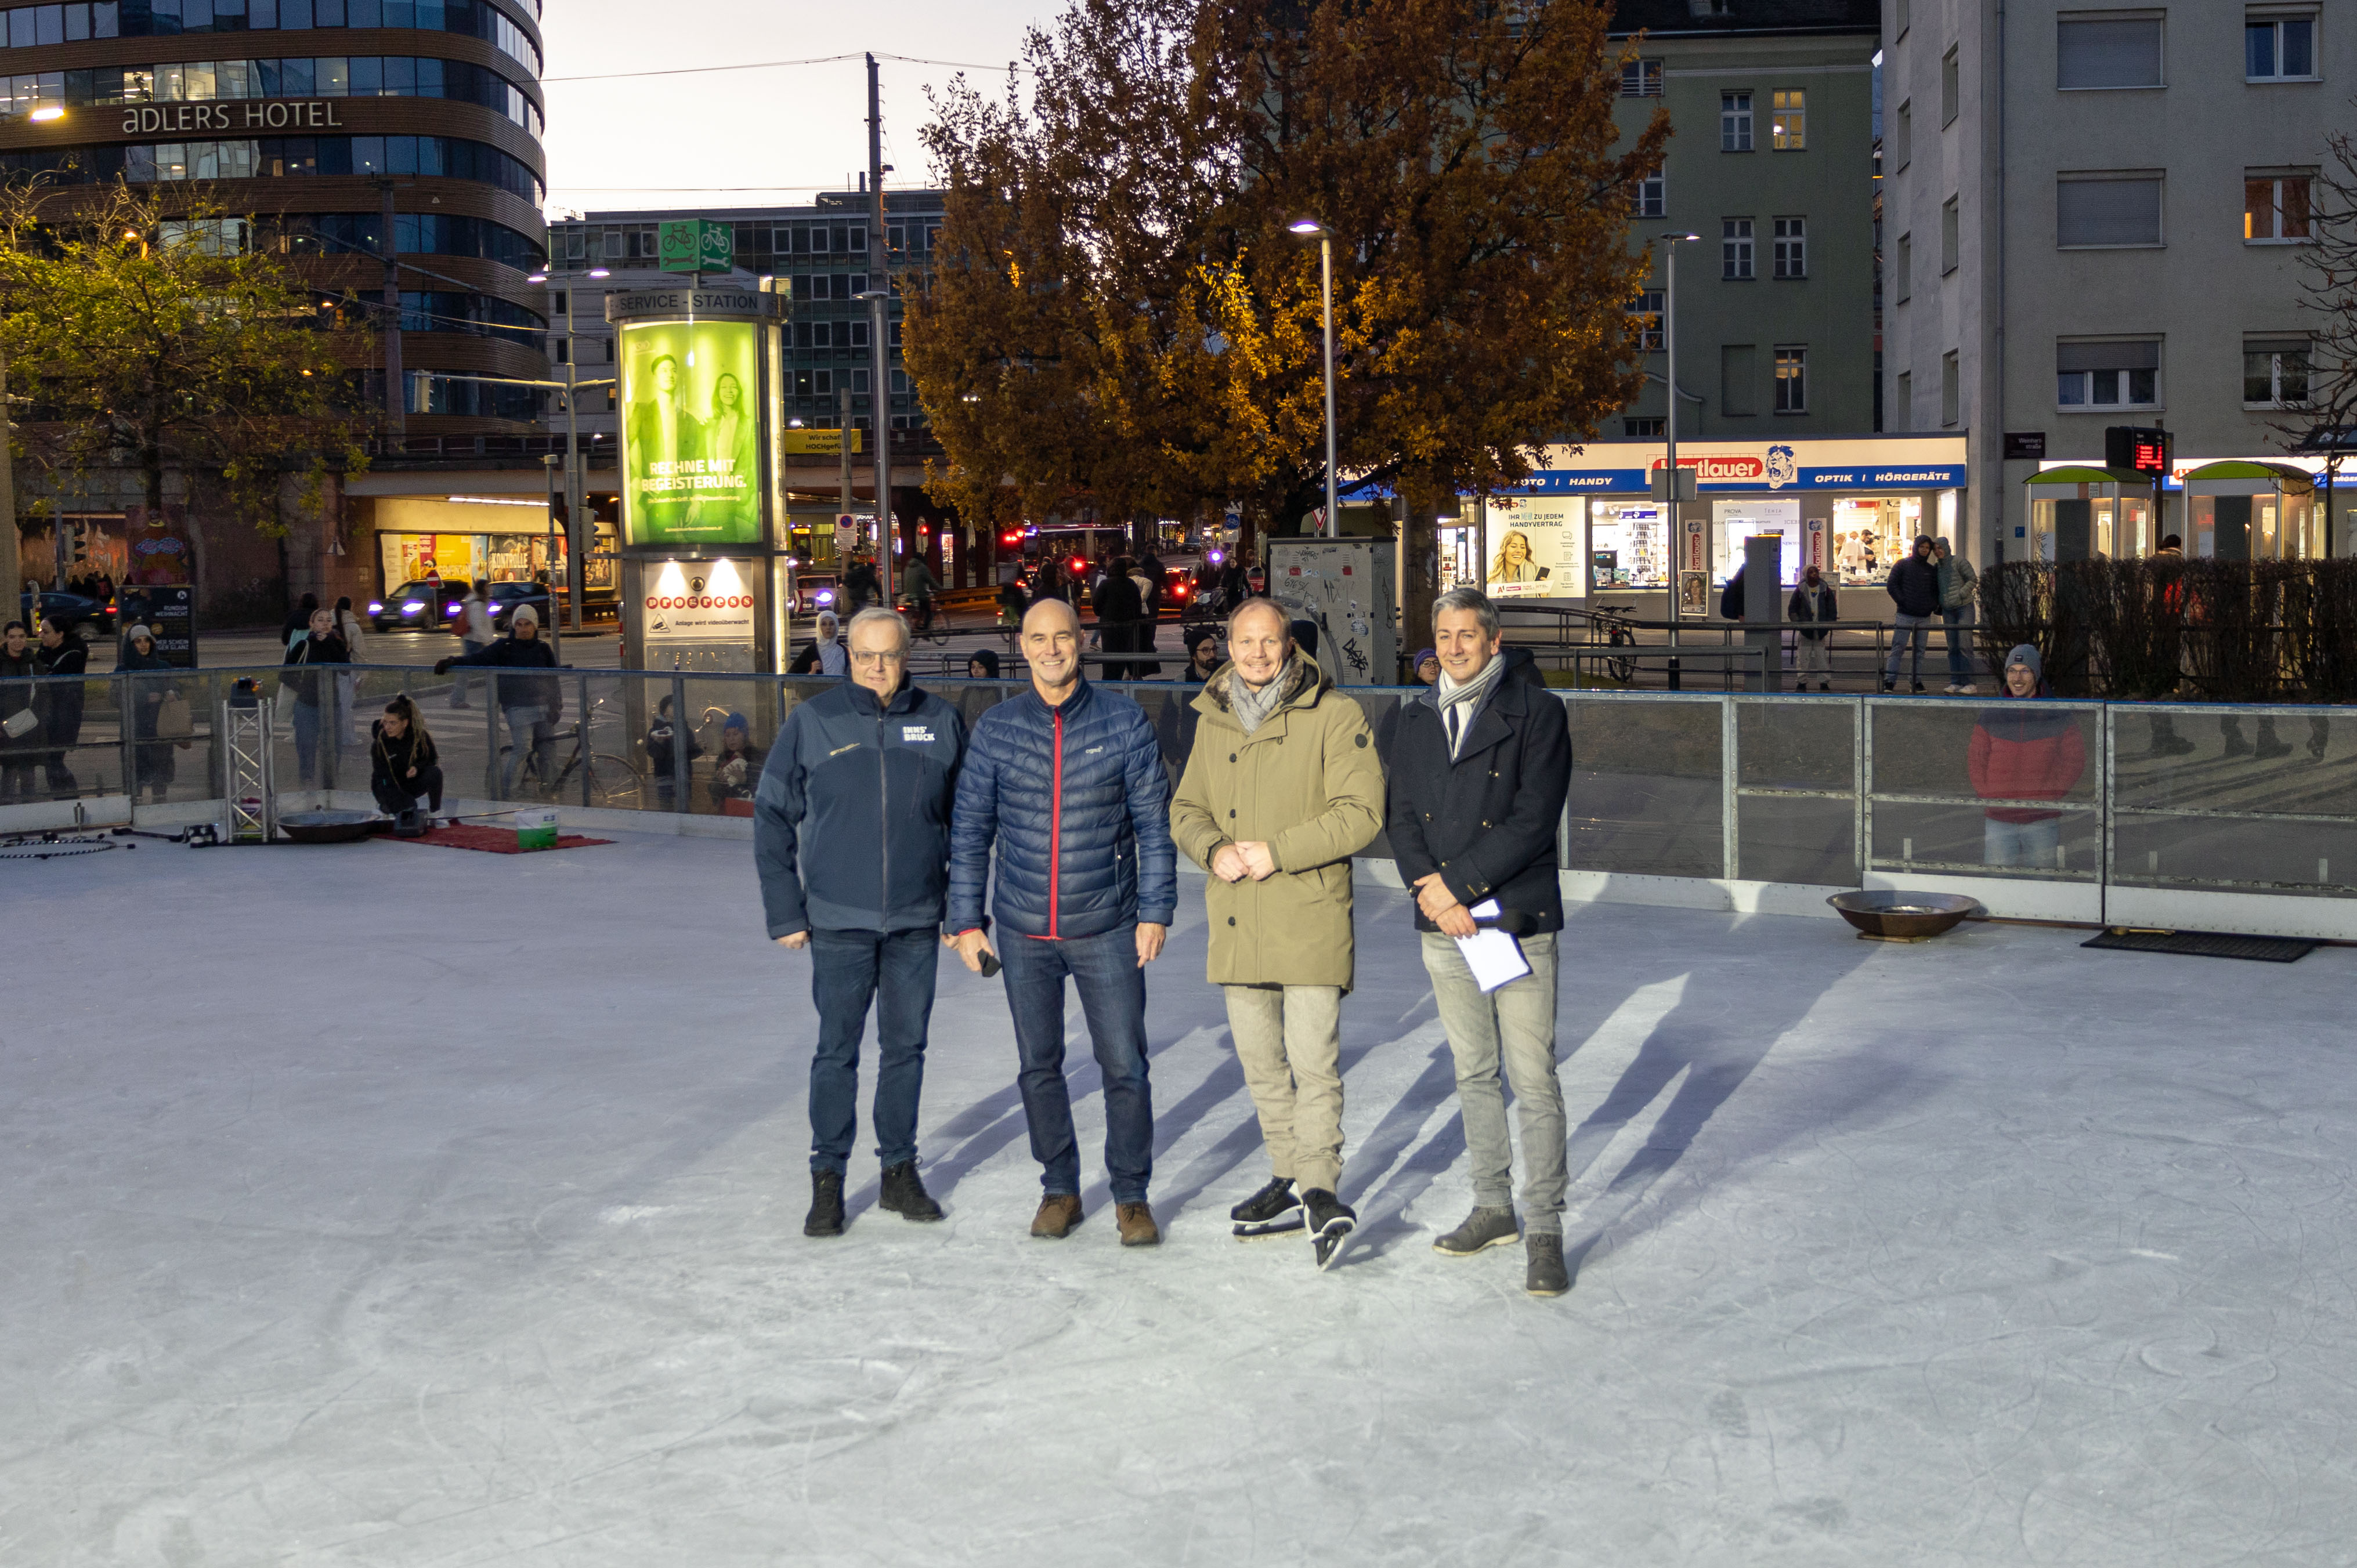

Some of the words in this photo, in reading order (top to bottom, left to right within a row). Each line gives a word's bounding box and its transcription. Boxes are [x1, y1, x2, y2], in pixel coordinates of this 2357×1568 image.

[245, 102, 342, 127] HOTEL
[620, 294, 679, 310] SERVICE
[693, 294, 758, 309] STATION
[649, 459, 705, 475] RECHNE
[708, 459, 735, 472] MIT
[641, 475, 747, 491] BEGEISTERUNG.
[1569, 477, 1613, 486] HANDY
[1814, 475, 1853, 483] OPTIK
[1875, 472, 1950, 481] HÖRGERÄTE
[492, 553, 527, 568] KONTROLLE
[646, 596, 753, 609] progress
[904, 733, 935, 741] BRUCK
